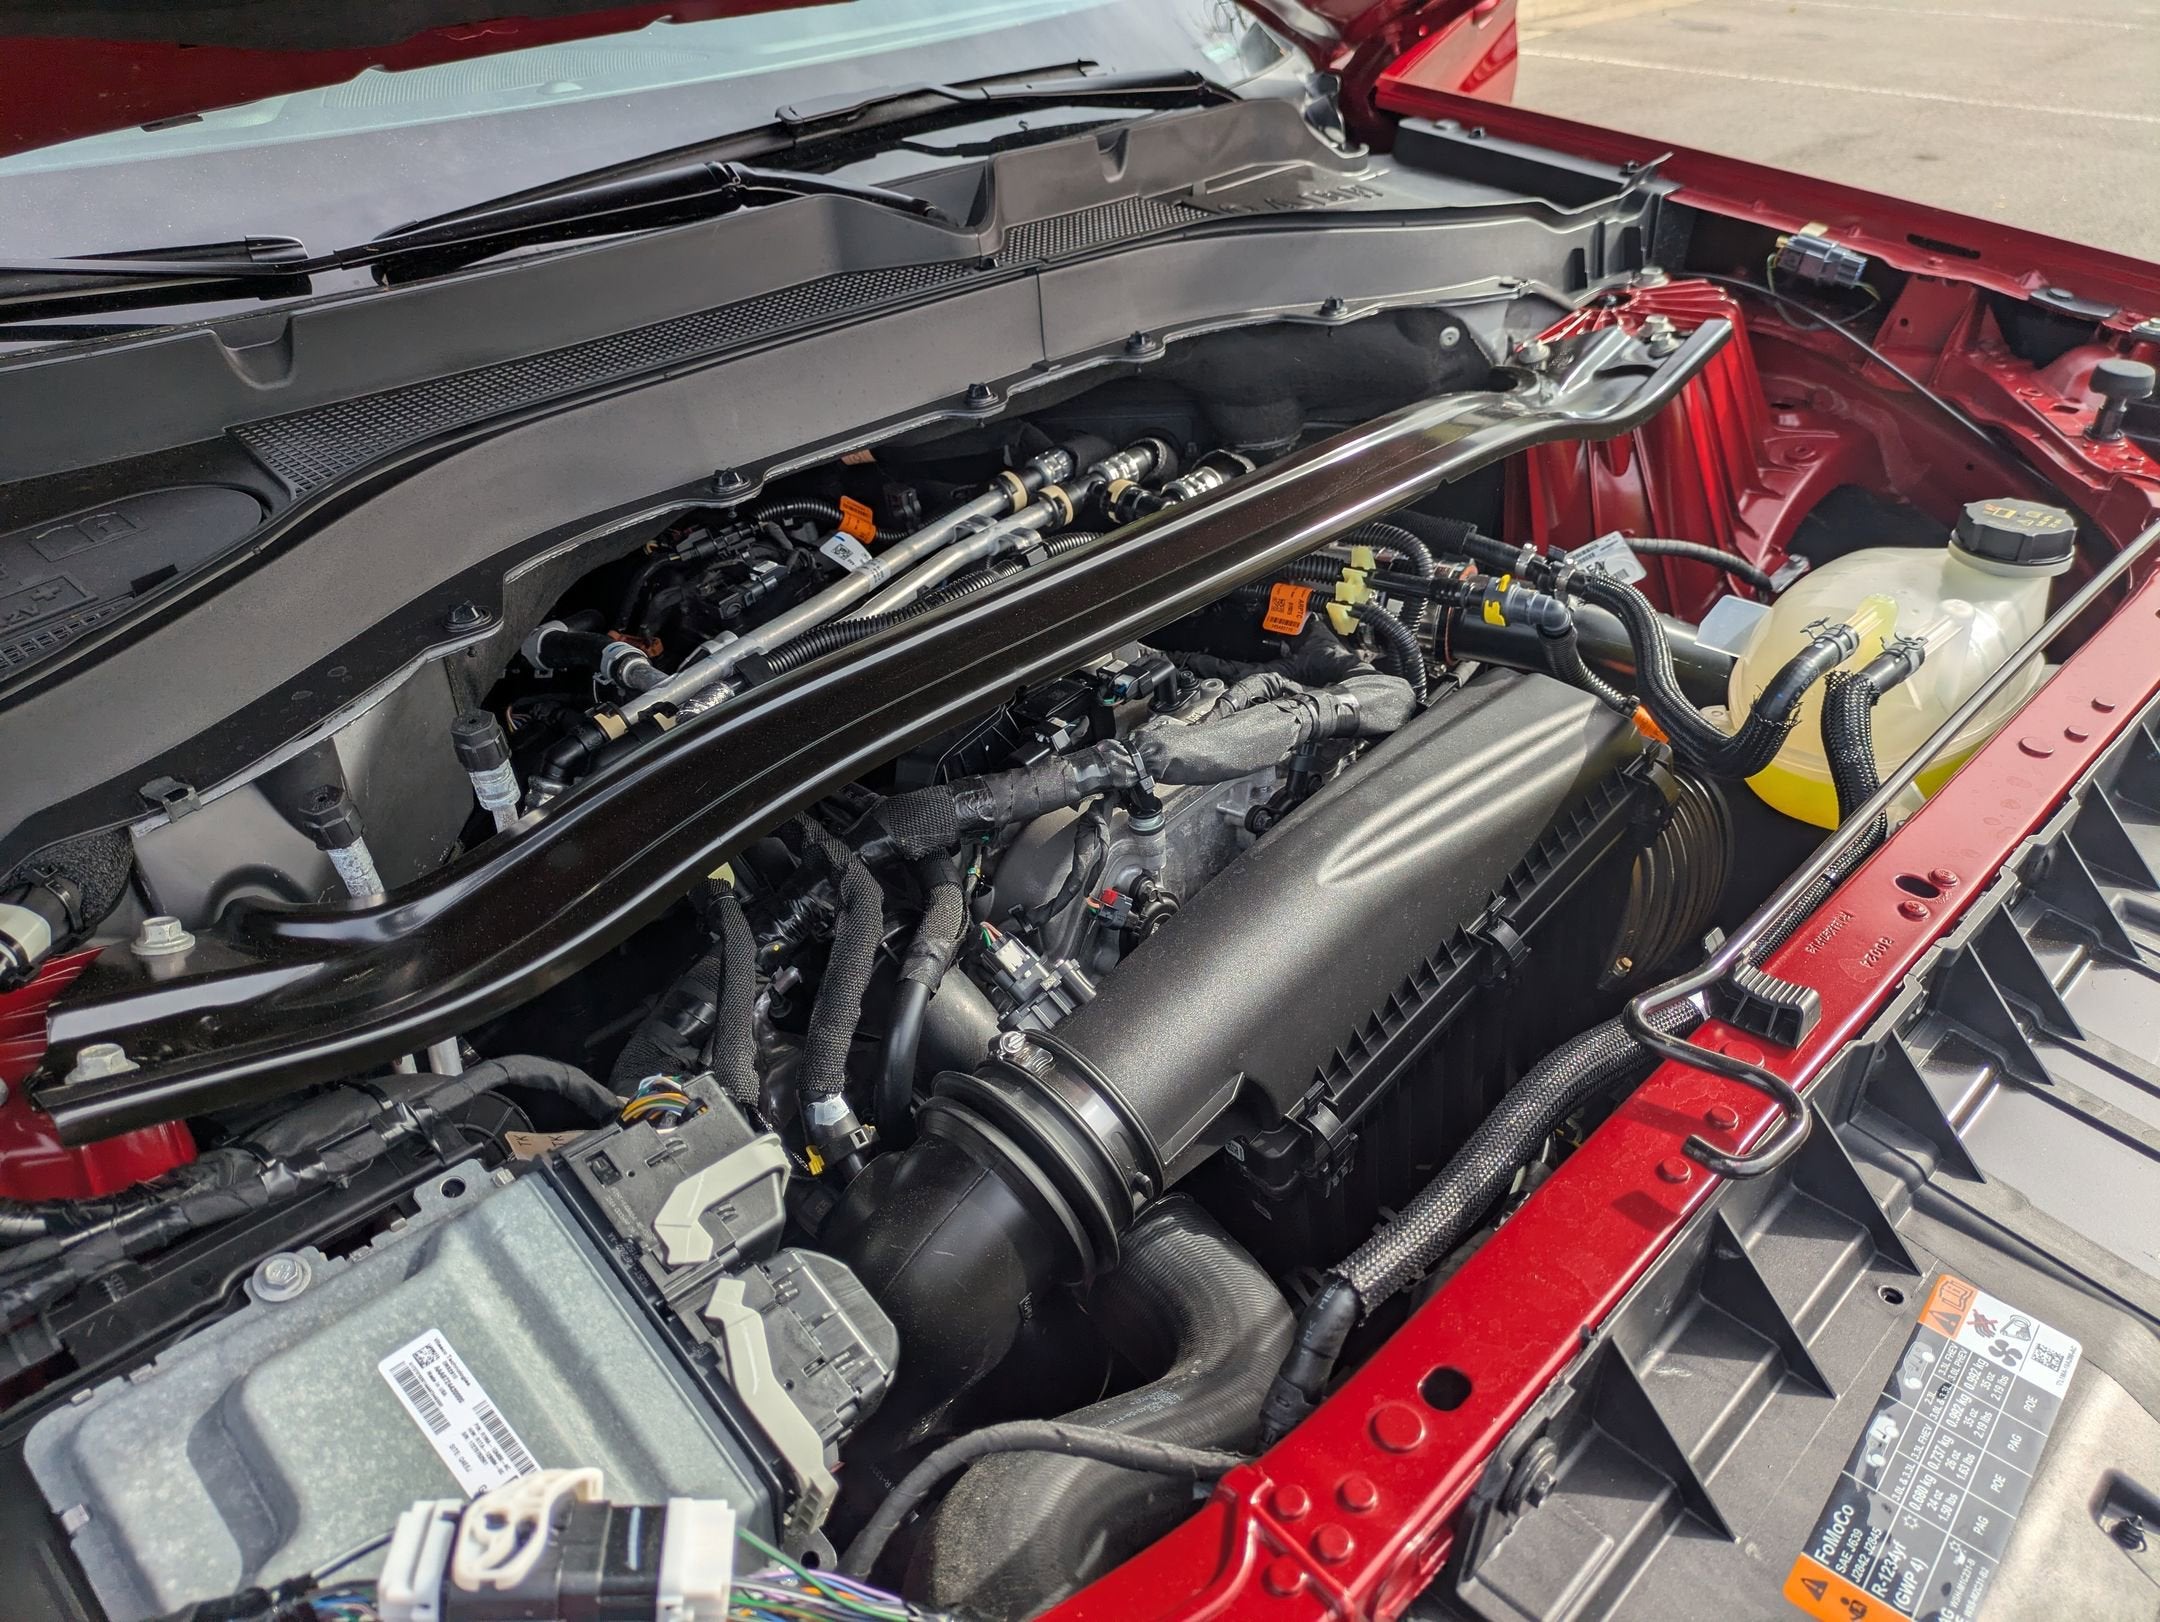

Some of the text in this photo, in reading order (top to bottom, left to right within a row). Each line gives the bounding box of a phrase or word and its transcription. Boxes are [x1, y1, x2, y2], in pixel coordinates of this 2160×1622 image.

[1944, 1342, 1959, 1361] FHEV
[1953, 1347, 1968, 1366] PHEV
[447, 1354, 471, 1387] Technologies
[1963, 1358, 1989, 1391] 0.992 kg
[1980, 1371, 1996, 1391] 35 oz
[1990, 1375, 2009, 1401] 2.19 lbs
[1945, 1393, 1972, 1428] 0.992 kg
[1963, 1408, 1979, 1428] 35 oz
[2023, 1394, 2038, 1413] POE
[1973, 1411, 1993, 1439] 2.19 lbs
[1911, 1423, 1932, 1460] 3.3L FHEV
[1927, 1434, 1955, 1470] 0.737 kg
[1951, 1449, 1961, 1461] oz
[2007, 1433, 2022, 1453] PAG
[1956, 1453, 1976, 1480] 1.63 lbs
[1891, 1485, 1906, 1501] 3.0L
[1902, 1463, 1916, 1478] 3.3L
[1908, 1473, 1937, 1511] 0.680 kg
[1990, 1473, 2007, 1494] POE
[1926, 1489, 1944, 1511] 24 oz
[1938, 1492, 1959, 1522] 1.50 lbs
[1814, 1504, 1855, 1565] FoMoCo
[1972, 1515, 1989, 1536] PAG
[1835, 1528, 1863, 1574] SAE J639
[1851, 1526, 1882, 1583] J2842 J2845
[1871, 1539, 1907, 1598] R-1234yf
[1893, 1557, 1929, 1612] (GWP 4)
